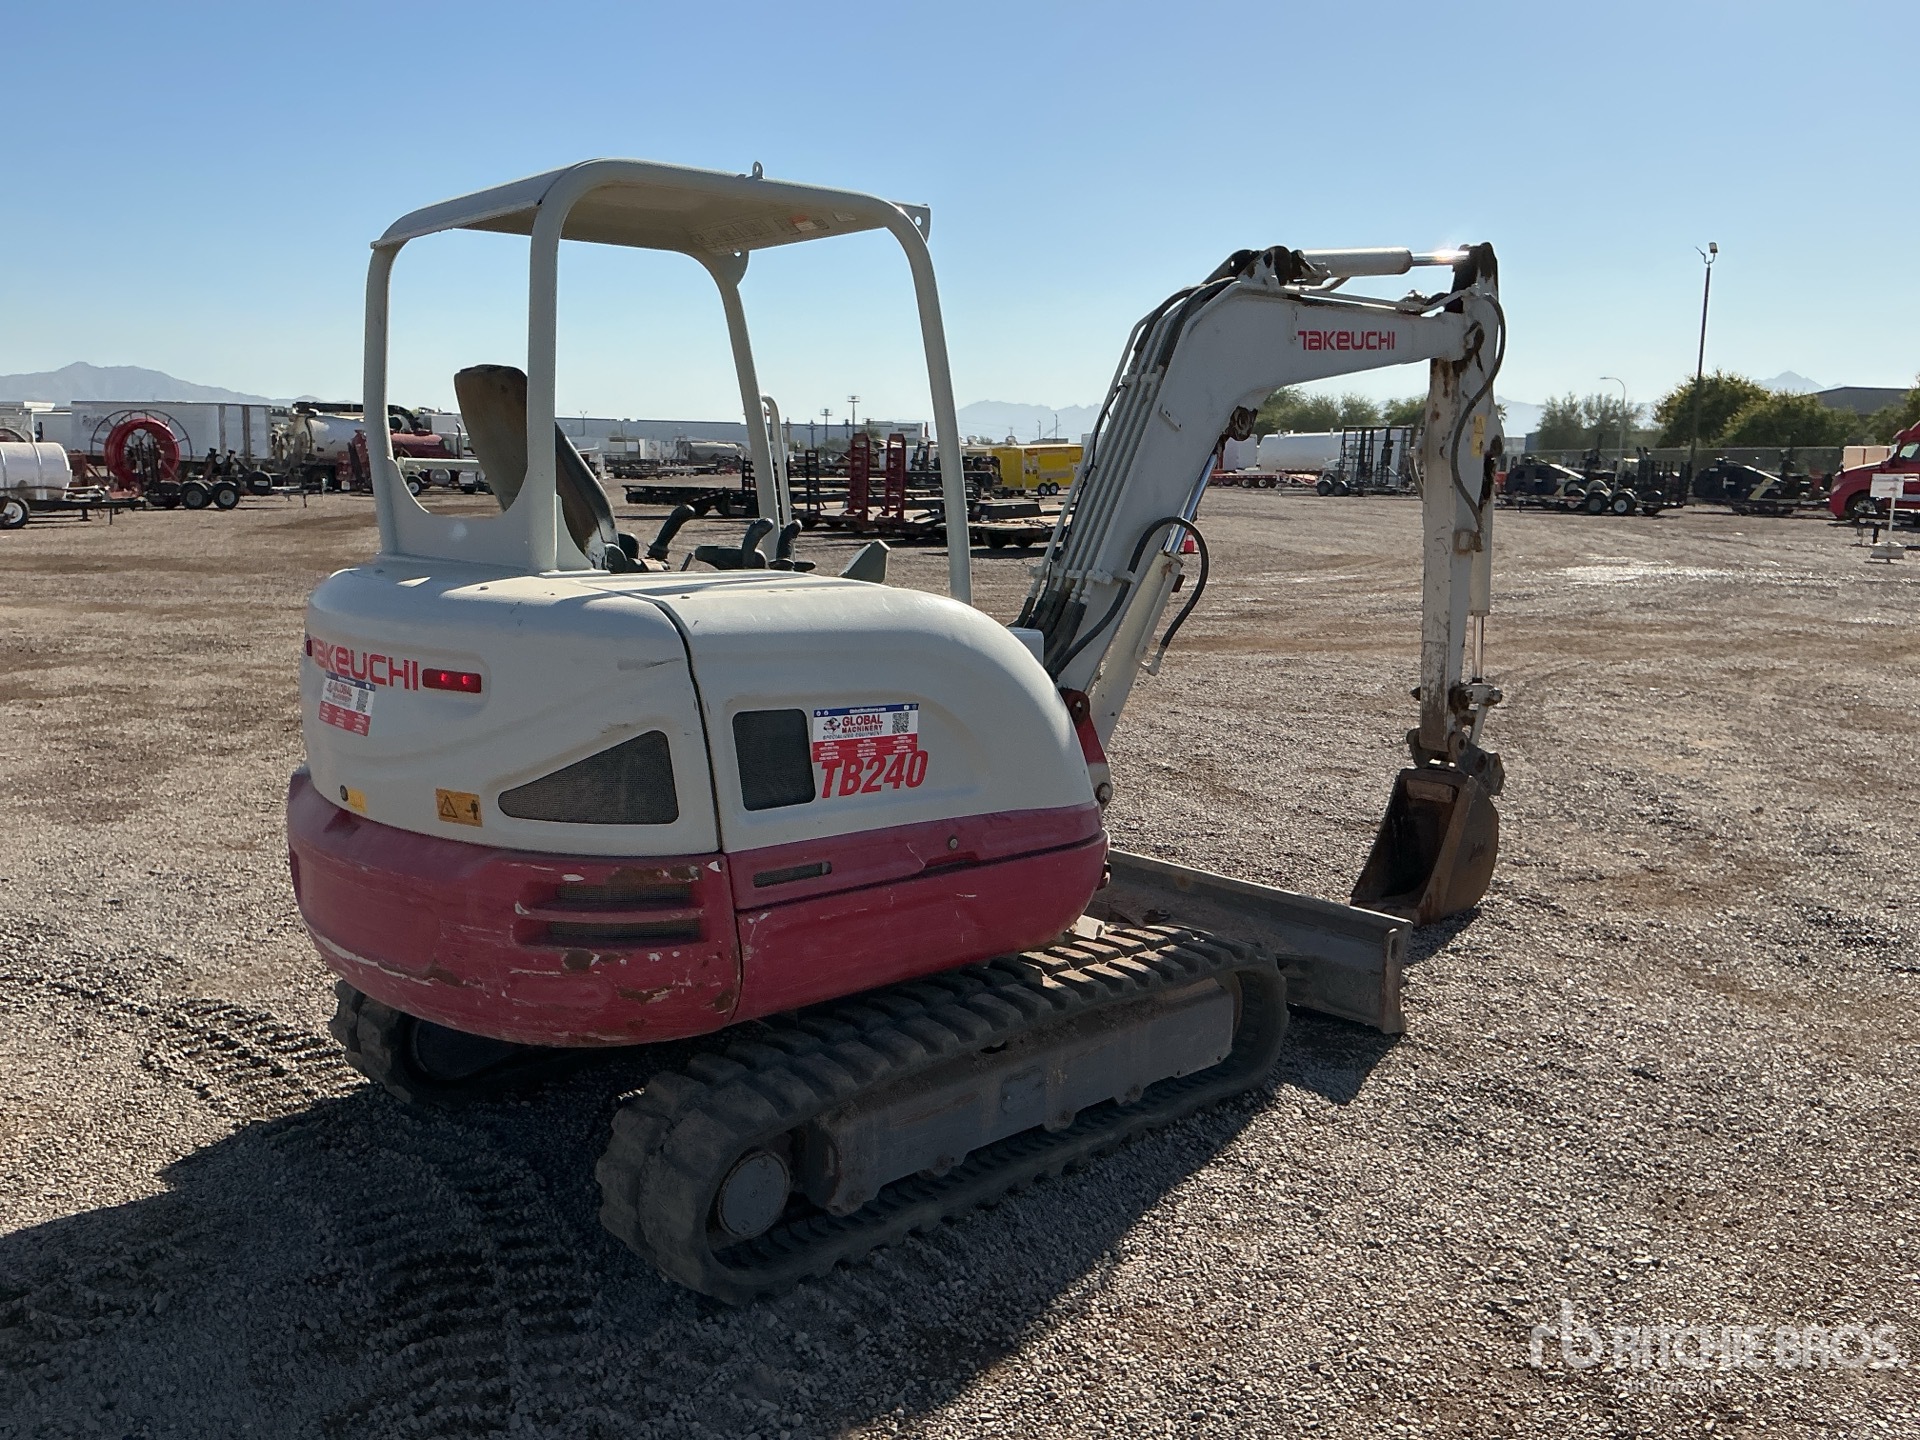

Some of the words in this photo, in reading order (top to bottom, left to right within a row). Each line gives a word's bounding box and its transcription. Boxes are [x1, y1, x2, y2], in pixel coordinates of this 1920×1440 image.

[842, 714, 883, 727] GLOBAL
[842, 724, 883, 734] MACHINERY
[821, 750, 929, 799] TB240
